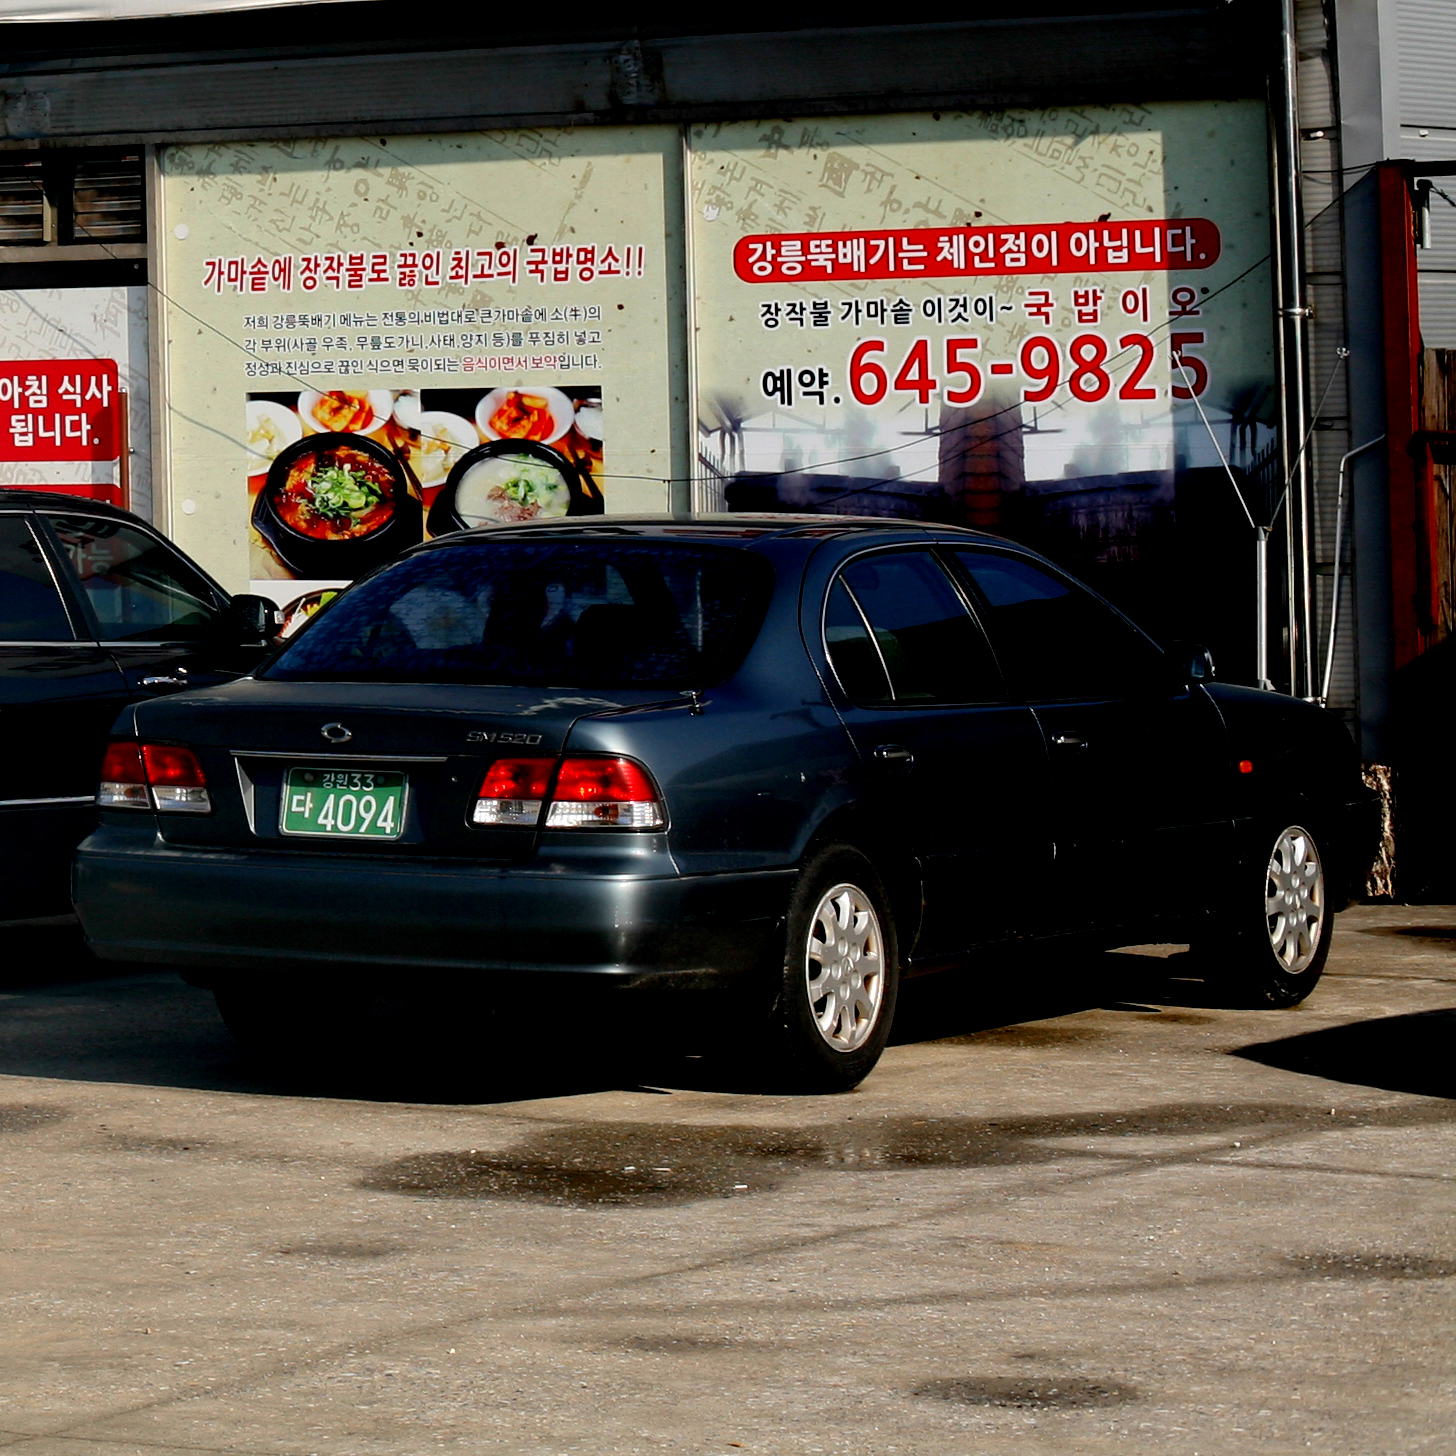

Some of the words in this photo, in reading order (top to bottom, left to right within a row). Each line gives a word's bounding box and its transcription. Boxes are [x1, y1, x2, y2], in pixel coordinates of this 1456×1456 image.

[747, 236, 929, 277] 강릉뚝배기는
[935, 230, 1058, 270] 체인점이
[1069, 225, 1207, 266] 아닙니다.
[203, 255, 293, 293] 가마솥에
[299, 253, 390, 290] 장작불로
[396, 250, 441, 288] 끓인
[448, 247, 518, 286] 최고의
[525, 245, 644, 283] 국밥명소!!
[243, 314, 269, 330] 저희
[272, 312, 337, 330] 강릉뚝배기
[339, 311, 379, 328] 메뉴는
[760, 299, 832, 329] 장작불
[840, 297, 913, 327] 가마솥
[244, 338, 258, 353] 각
[527, 330, 570, 347] 푸짐히
[574, 330, 602, 345] 넣고
[244, 360, 283, 377] 정성과
[285, 359, 336, 376] 진심으로
[462, 355, 529, 373] 음식이면서
[761, 367, 842, 406] 예약.
[849, 331, 1208, 405] 645-9825
[57, 373, 113, 408] 식사
[8, 412, 101, 447] 됩니다.
[291, 791, 314, 819] 다
[317, 793, 396, 834] 4094
